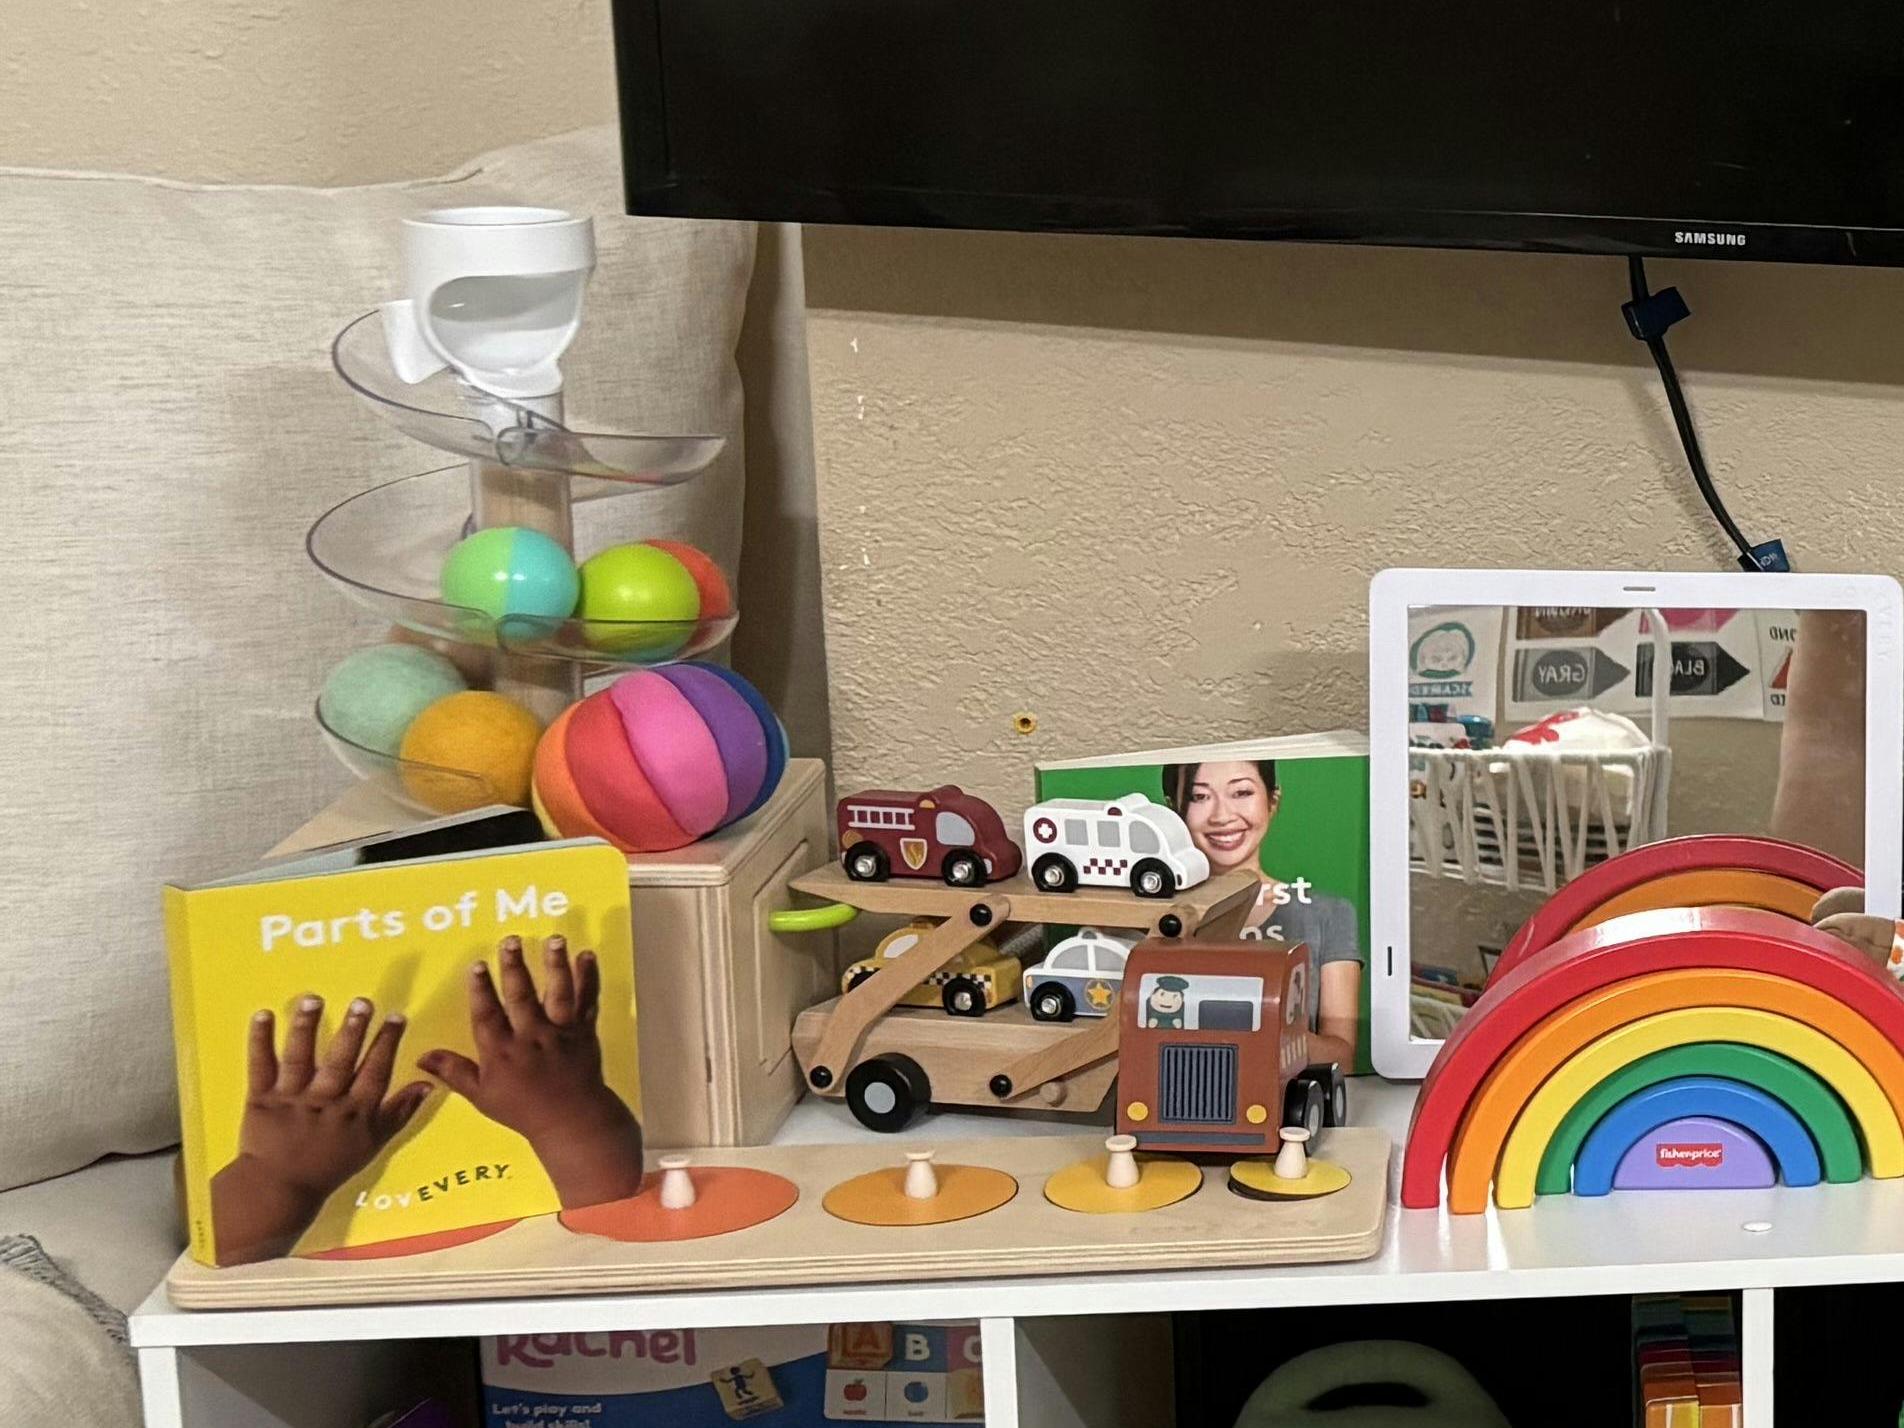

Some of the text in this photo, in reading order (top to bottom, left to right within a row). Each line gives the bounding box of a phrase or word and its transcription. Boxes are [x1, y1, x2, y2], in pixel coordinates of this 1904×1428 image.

[1675, 231, 1746, 246] SAMSUNG
[1256, 876, 1312, 906] rst
[260, 884, 569, 952] Parts of Me
[905, 1333, 930, 1361] B
[492, 1403, 602, 1417] Let's play and
